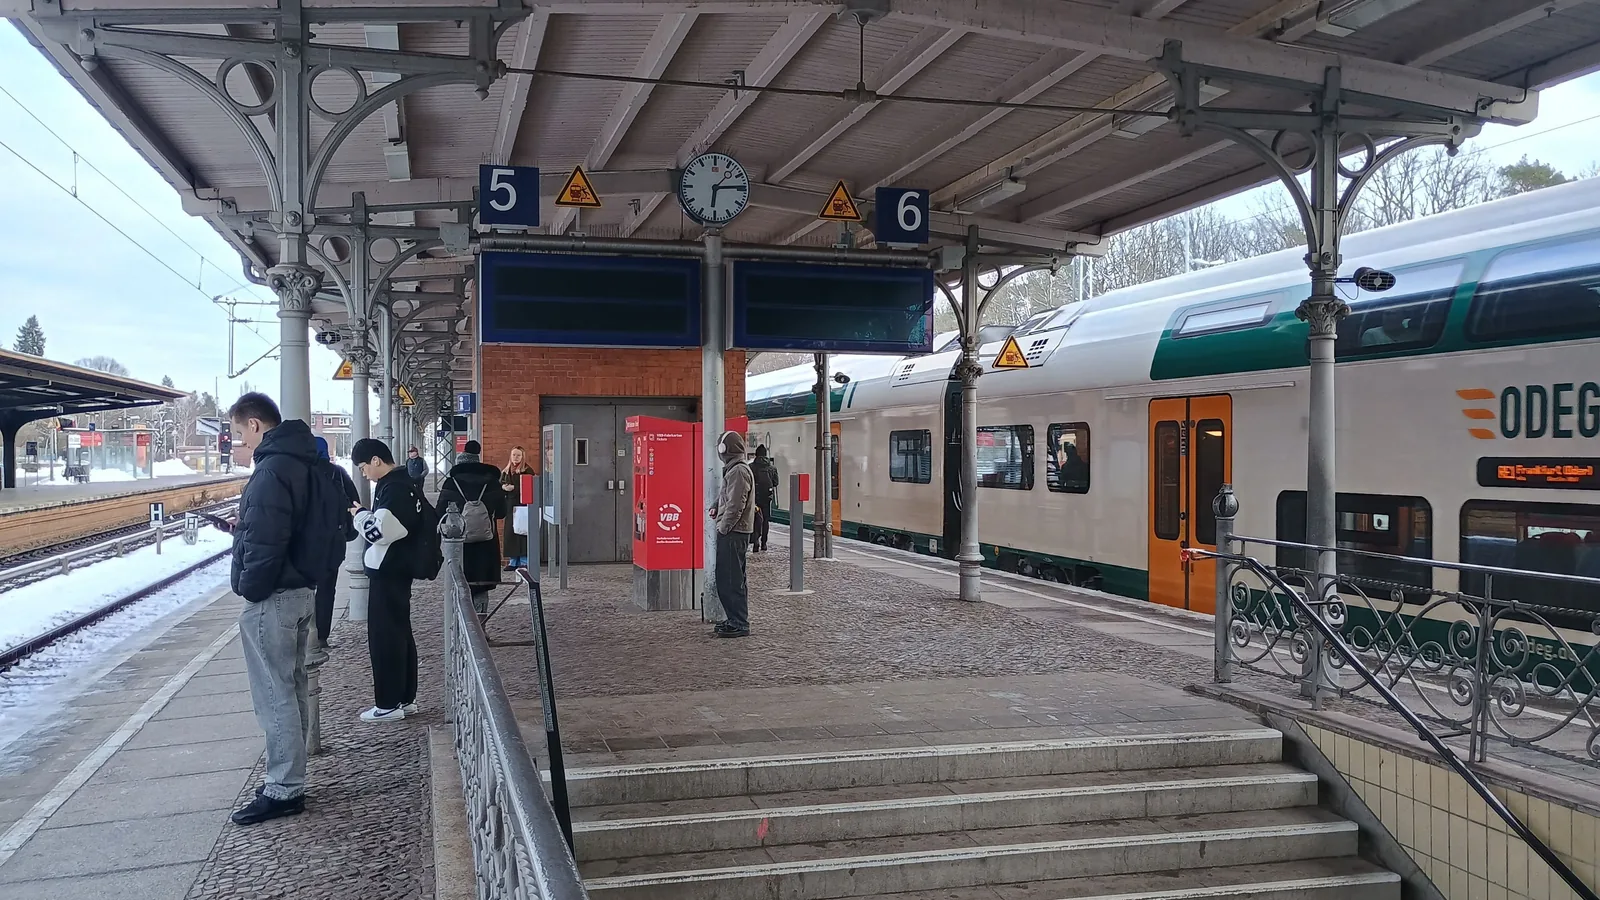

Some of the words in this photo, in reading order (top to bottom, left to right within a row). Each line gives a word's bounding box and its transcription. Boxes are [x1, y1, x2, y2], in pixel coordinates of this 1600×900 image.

[489, 168, 517, 212] 5
[897, 191, 922, 231] 6
[1501, 381, 1600, 439] ODEG
[150, 503, 163, 521] H
[660, 513, 680, 522] VBB
